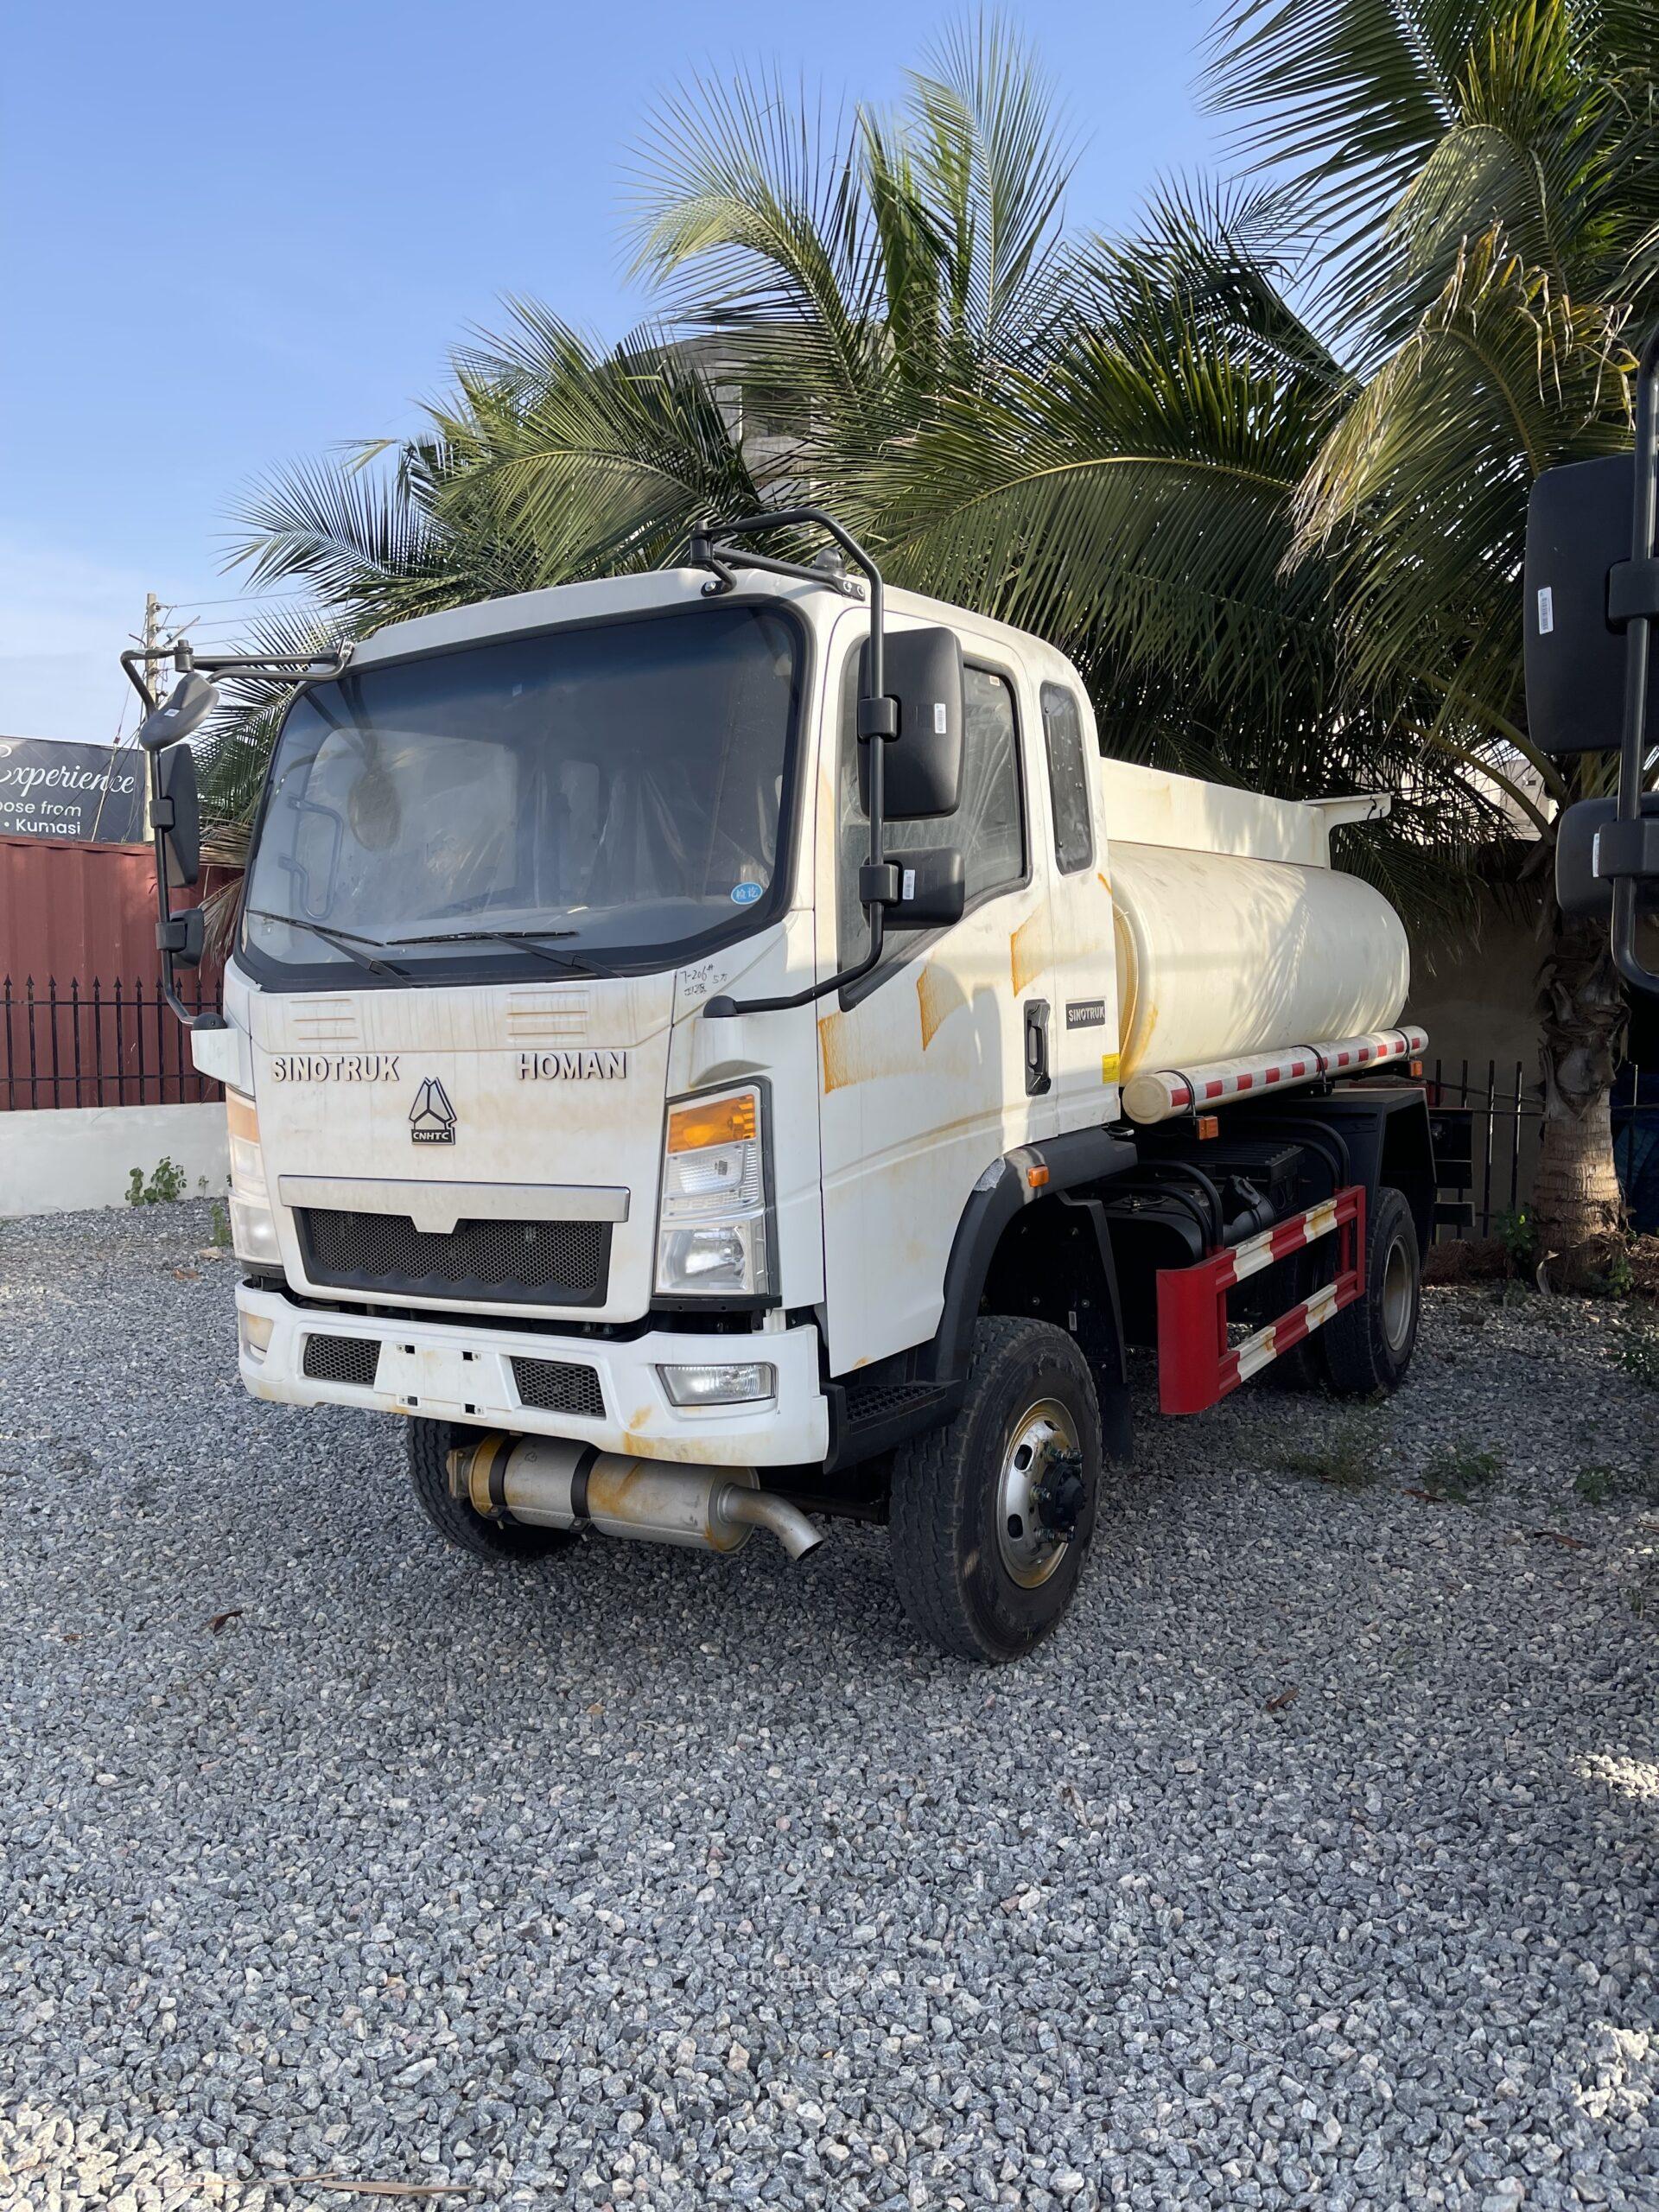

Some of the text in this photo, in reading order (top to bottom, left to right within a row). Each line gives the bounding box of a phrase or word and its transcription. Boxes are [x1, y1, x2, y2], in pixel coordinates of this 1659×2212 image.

[0, 800, 82, 817] ose from
[16, 818, 81, 836] Kumasi
[1068, 1006, 1106, 1022] SINOTRUK
[271, 1055, 400, 1083] SINOTRUK
[518, 1051, 626, 1080] HOMAN
[413, 1131, 450, 1141] CNHTC
